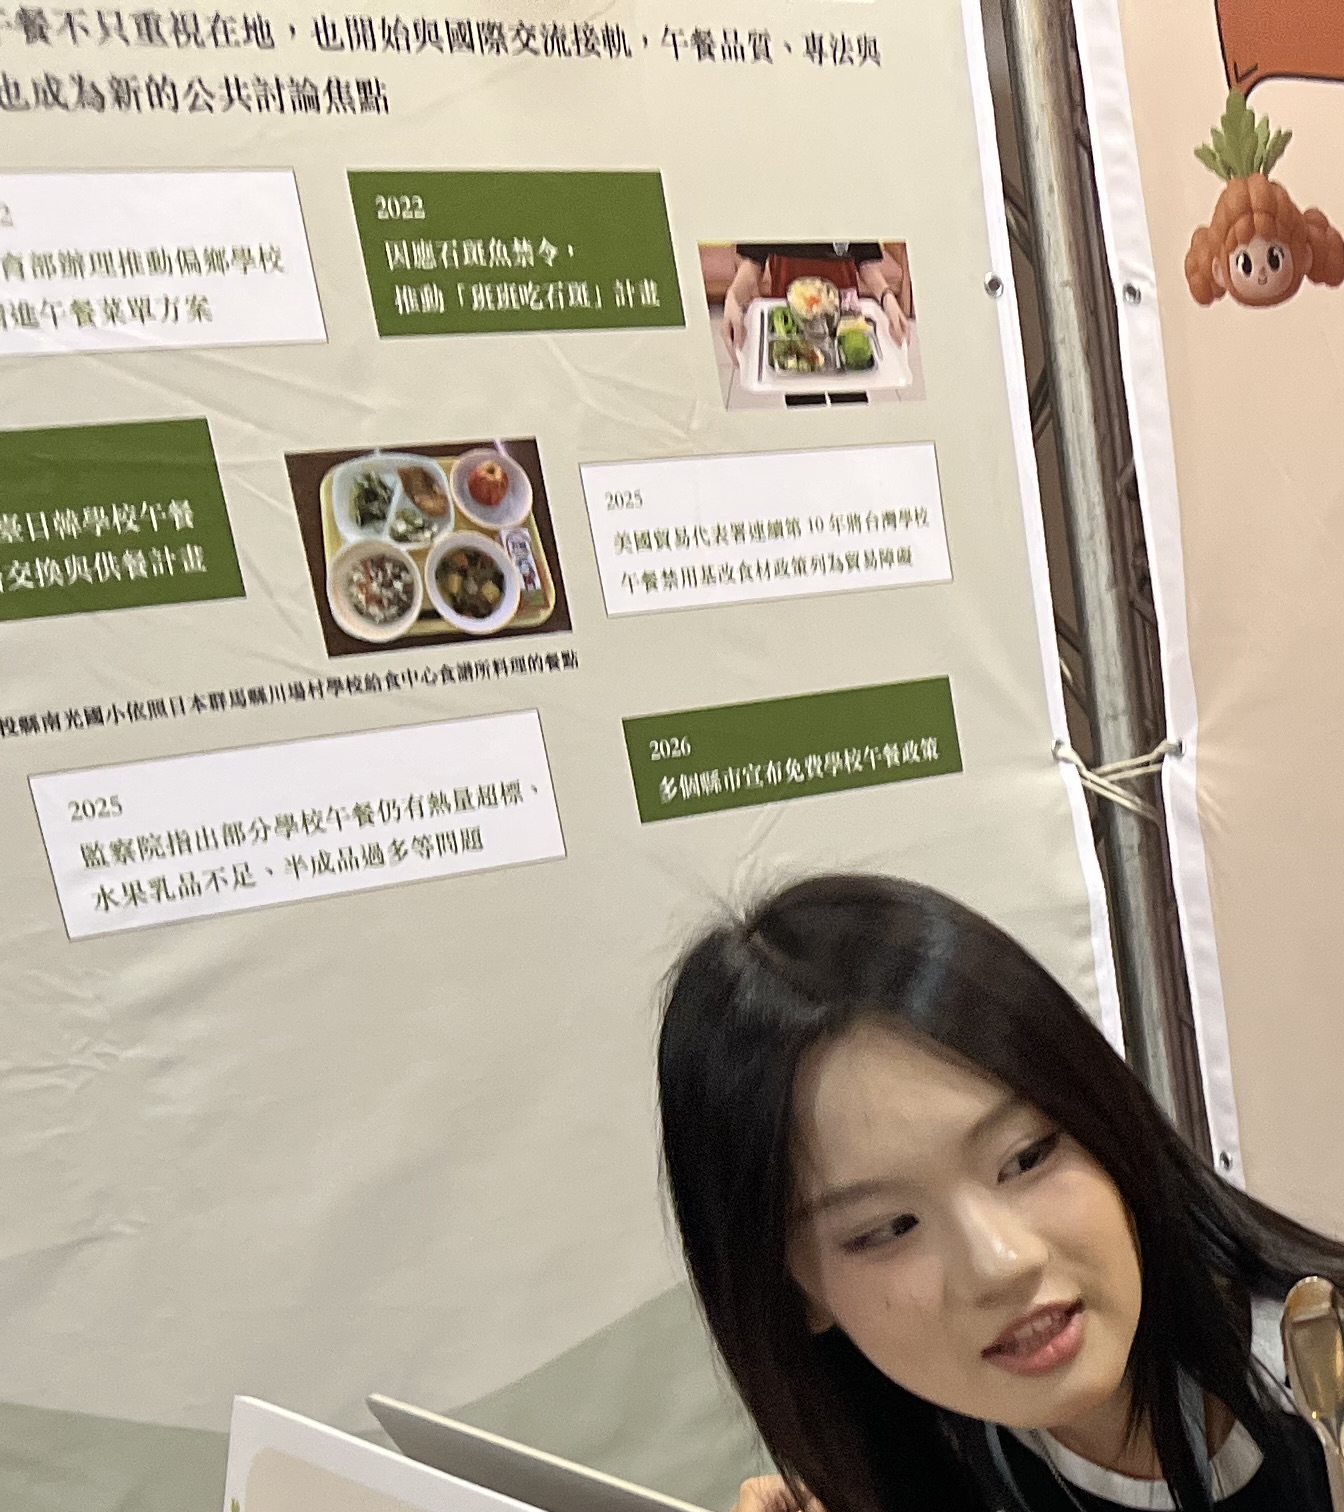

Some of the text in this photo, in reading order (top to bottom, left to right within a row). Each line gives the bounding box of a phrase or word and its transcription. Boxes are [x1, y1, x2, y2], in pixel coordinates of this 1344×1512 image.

[376, 194, 425, 219] 2022
[605, 489, 643, 511] 2025
[807, 515, 825, 534] 10
[649, 735, 692, 761] 2026
[68, 795, 123, 822] 2025
[92, 825, 485, 913] 水果乳品不足、半成品過多等問題
